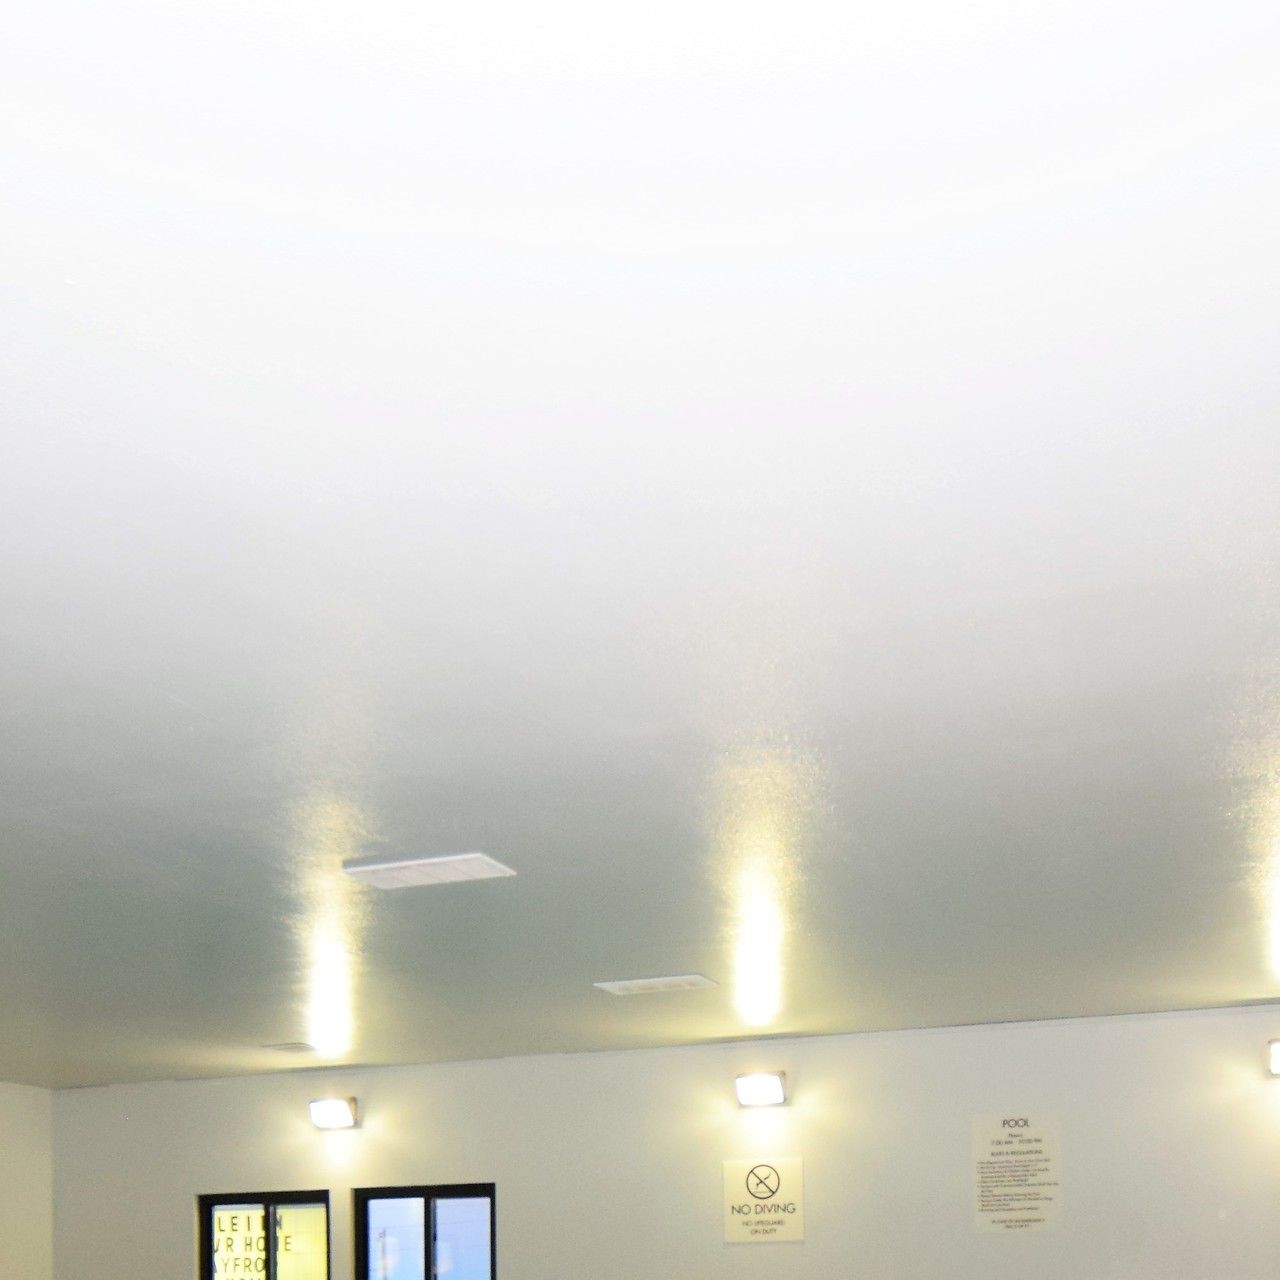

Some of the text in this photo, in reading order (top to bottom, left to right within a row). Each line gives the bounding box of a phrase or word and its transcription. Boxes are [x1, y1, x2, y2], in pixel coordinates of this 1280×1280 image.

[1002, 1118, 1030, 1128] POOL
[731, 1203, 796, 1215] NO DIVING
[245, 1236, 291, 1252] HOE
